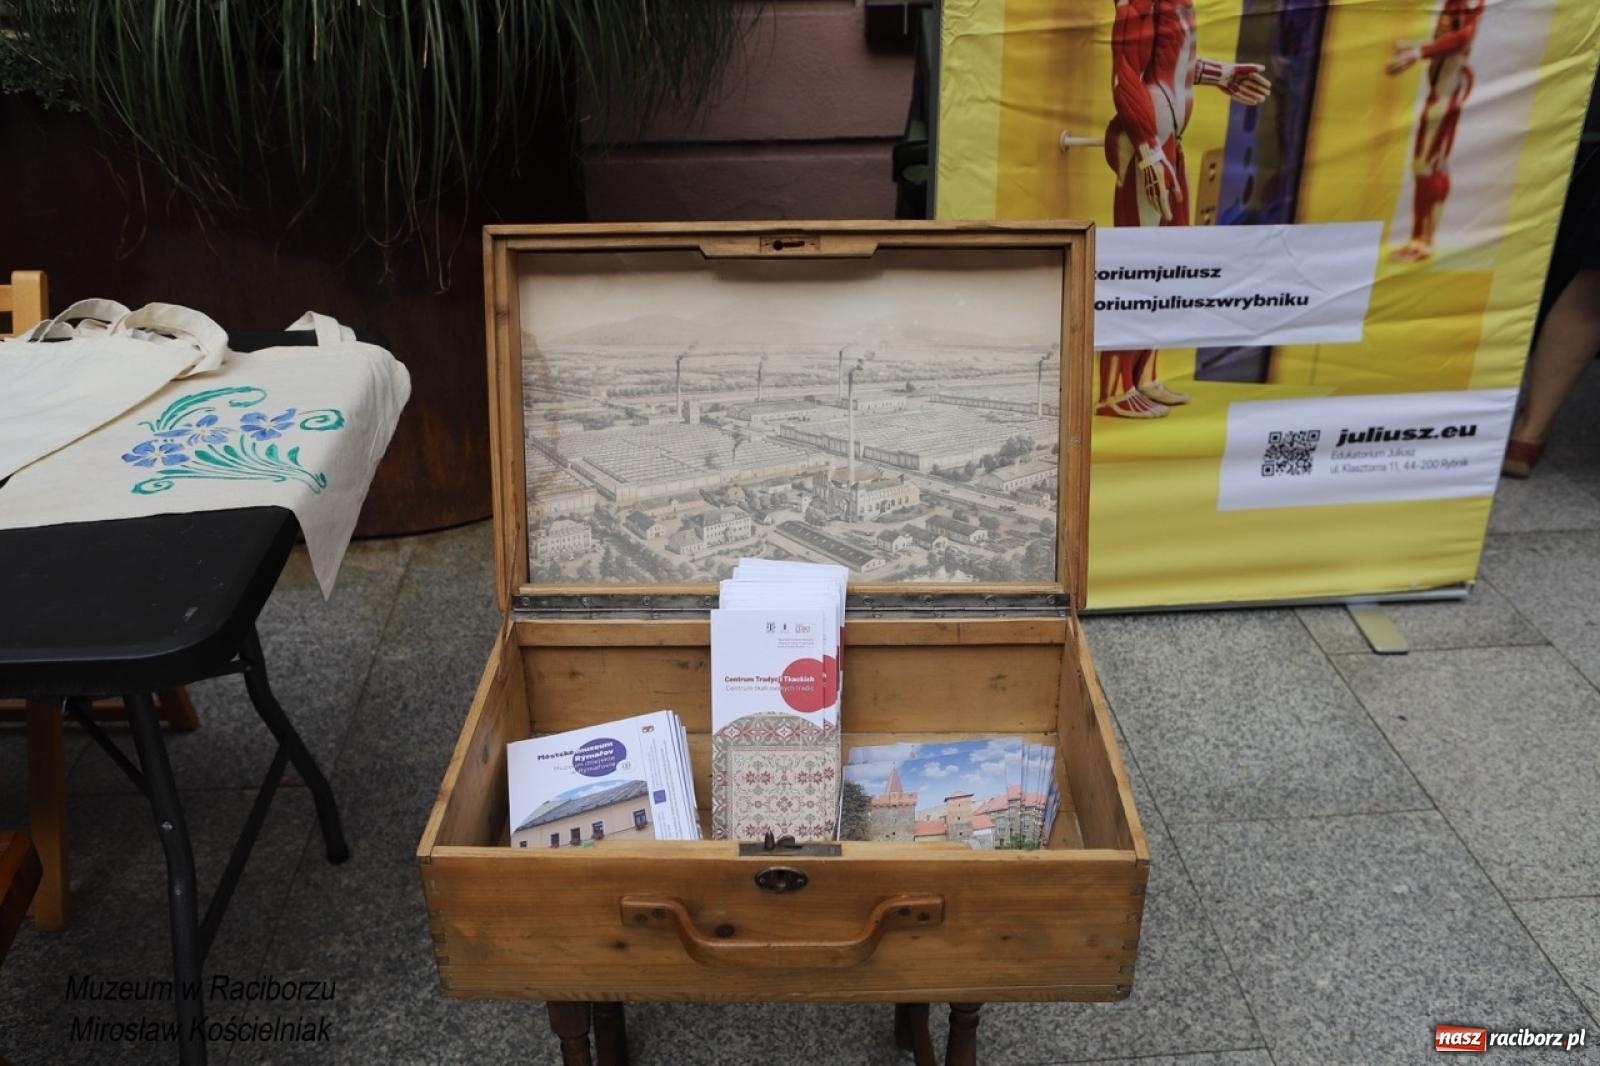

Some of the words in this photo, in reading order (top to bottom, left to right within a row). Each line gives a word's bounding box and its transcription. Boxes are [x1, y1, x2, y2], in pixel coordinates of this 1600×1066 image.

[1094, 265, 1222, 282] oriumjuliusz
[1336, 424, 1478, 447] juliusz.eu
[1403, 459, 1440, 471] 44-200
[724, 675, 755, 683] Centrum
